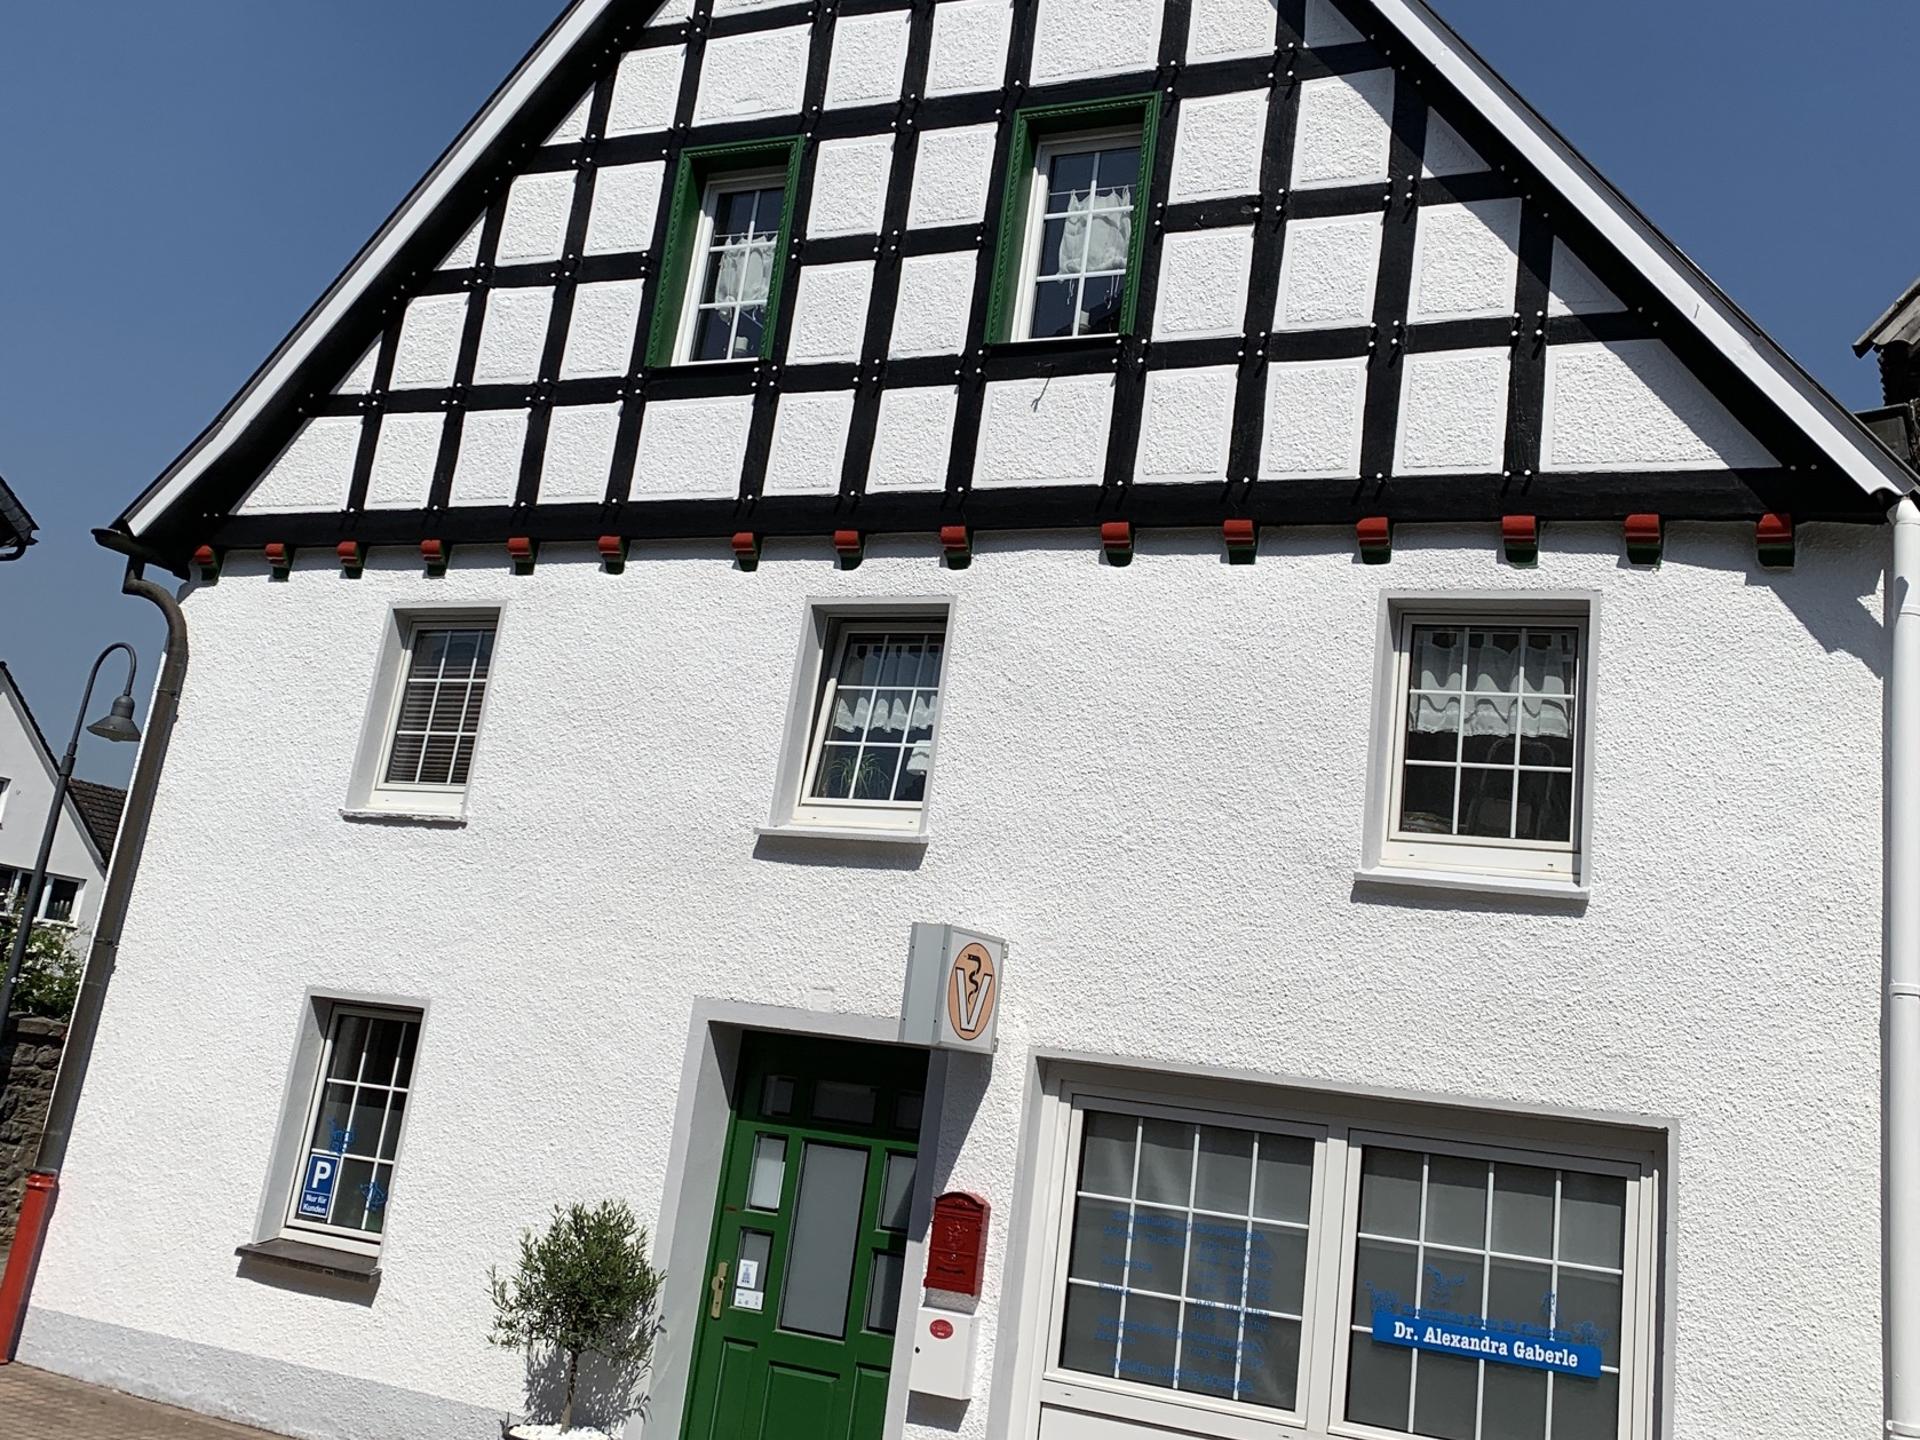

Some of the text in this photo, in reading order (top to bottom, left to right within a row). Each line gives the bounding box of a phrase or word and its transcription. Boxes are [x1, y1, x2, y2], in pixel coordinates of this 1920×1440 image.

[312, 1161, 331, 1188] P
[306, 1194, 317, 1203] Nur
[303, 1203, 326, 1213] Kunden
[1393, 1321, 1418, 1341] Dr.
[1424, 1327, 1508, 1356] Alexandra
[1514, 1341, 1578, 1367] Gaberle
